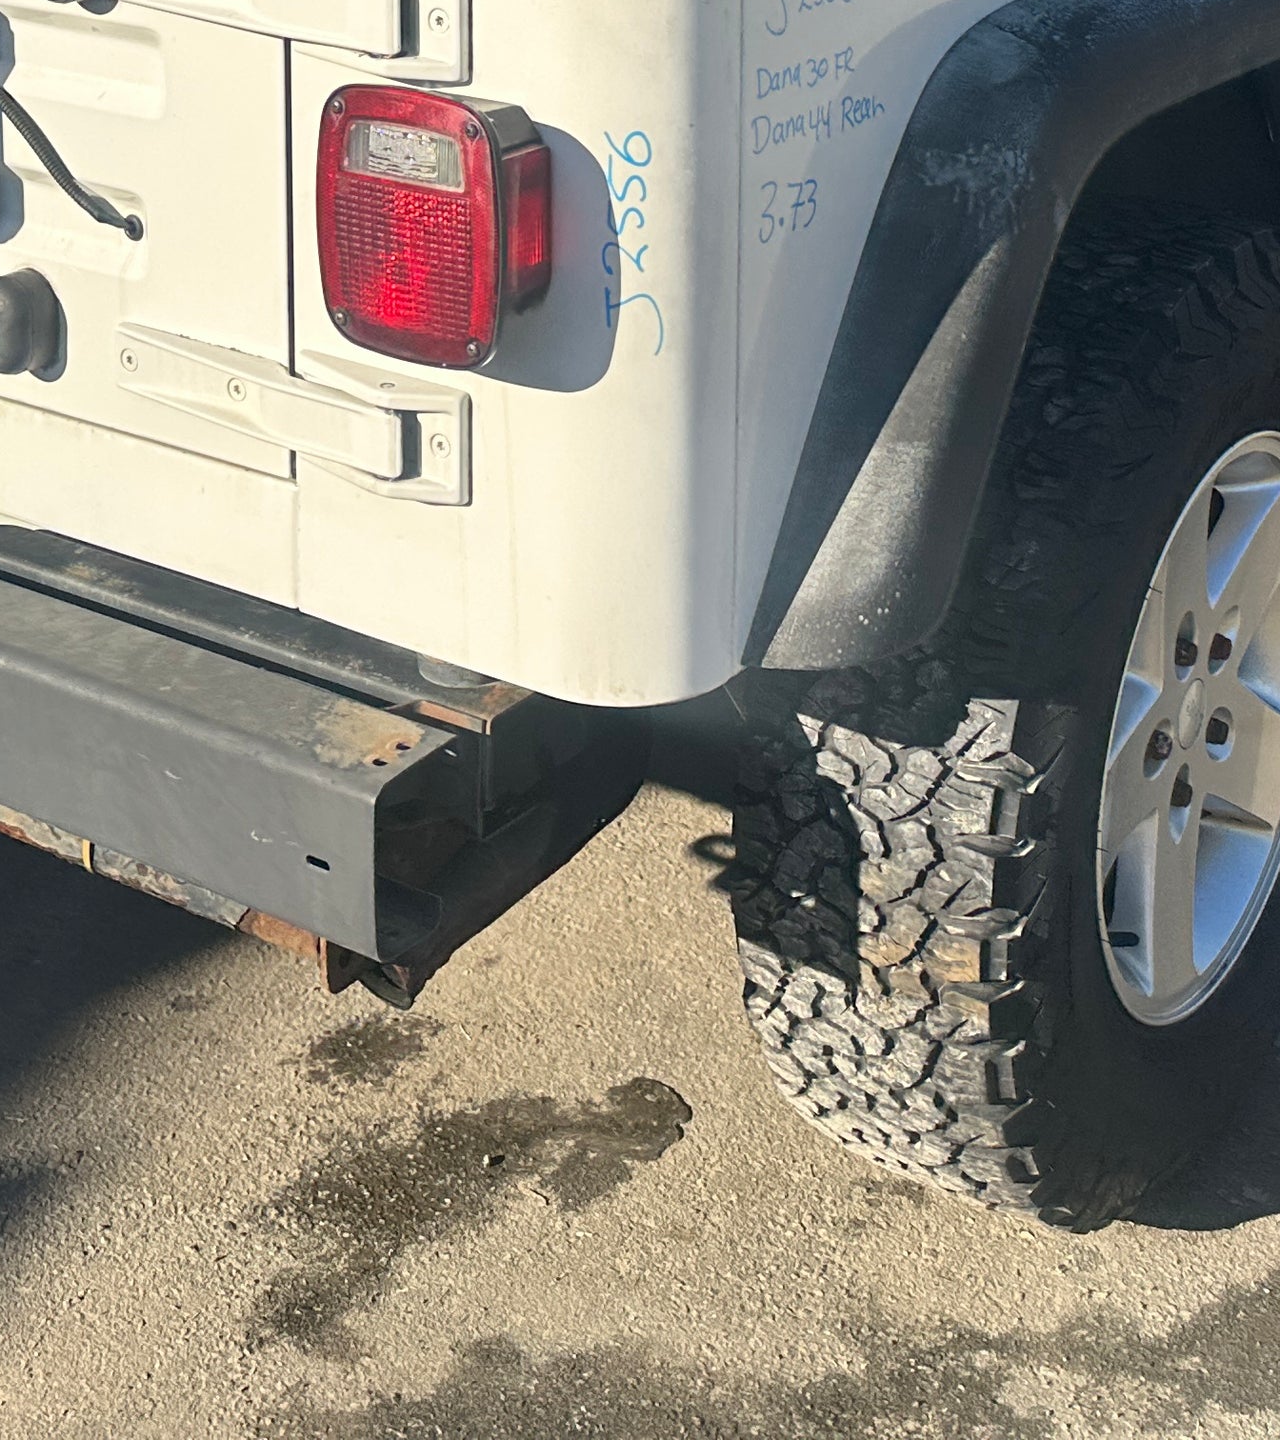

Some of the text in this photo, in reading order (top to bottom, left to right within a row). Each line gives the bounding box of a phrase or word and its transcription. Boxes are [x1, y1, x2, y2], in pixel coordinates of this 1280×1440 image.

[751, 115, 806, 155] Dana
[602, 130, 665, 357] J2556
[758, 178, 819, 245] 3.73
